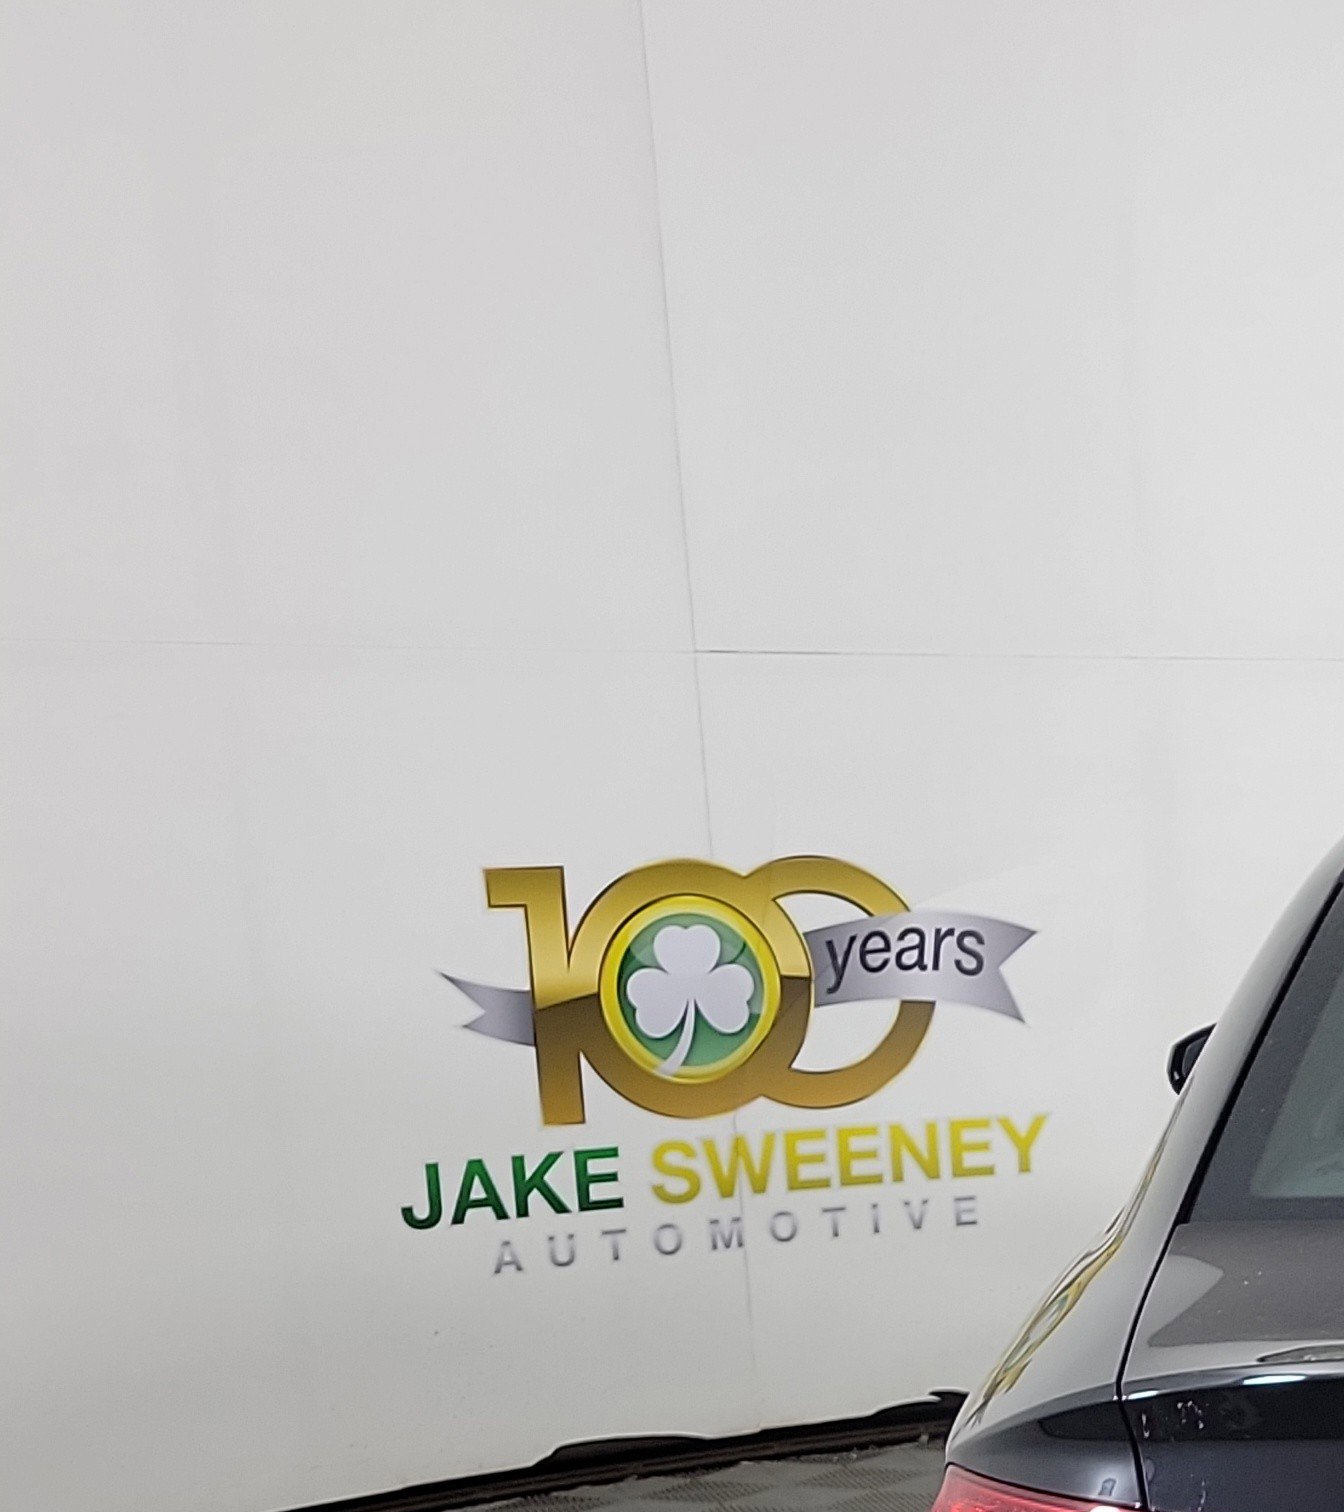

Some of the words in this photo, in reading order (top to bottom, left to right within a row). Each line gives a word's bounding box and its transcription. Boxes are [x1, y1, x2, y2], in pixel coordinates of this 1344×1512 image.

[482, 855, 936, 1127] 100
[825, 926, 987, 994] years
[400, 1145, 625, 1230] JAKE
[650, 1111, 1050, 1206] SWEENEY
[493, 1195, 979, 1277] AUTOMOTIVE
